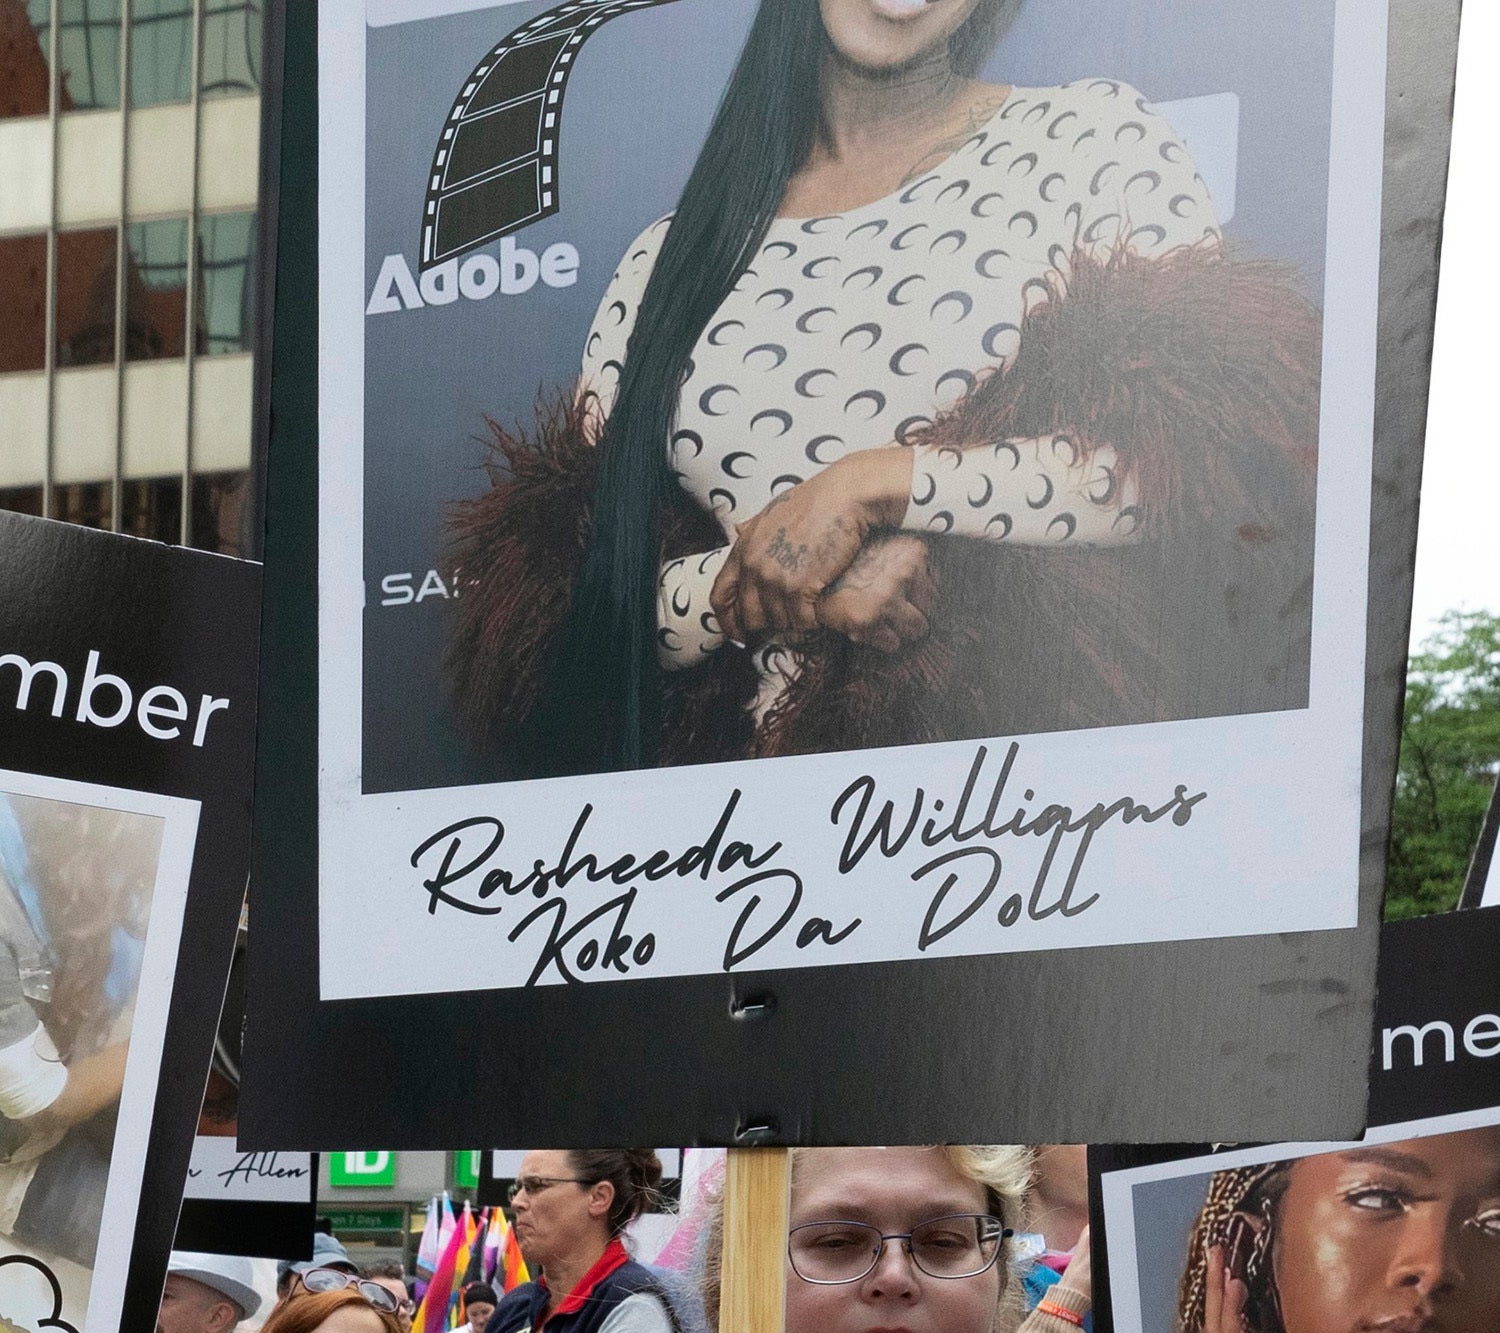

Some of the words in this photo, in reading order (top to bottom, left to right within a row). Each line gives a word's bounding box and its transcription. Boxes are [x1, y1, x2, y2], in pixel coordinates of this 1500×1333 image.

[411, 788, 781, 915] Rasheeda
[832, 742, 1208, 874] Williams
[508, 886, 656, 988] Koko
[717, 868, 863, 973] Da
[911, 822, 1100, 951] Doll
[217, 1151, 309, 1188] Allen
